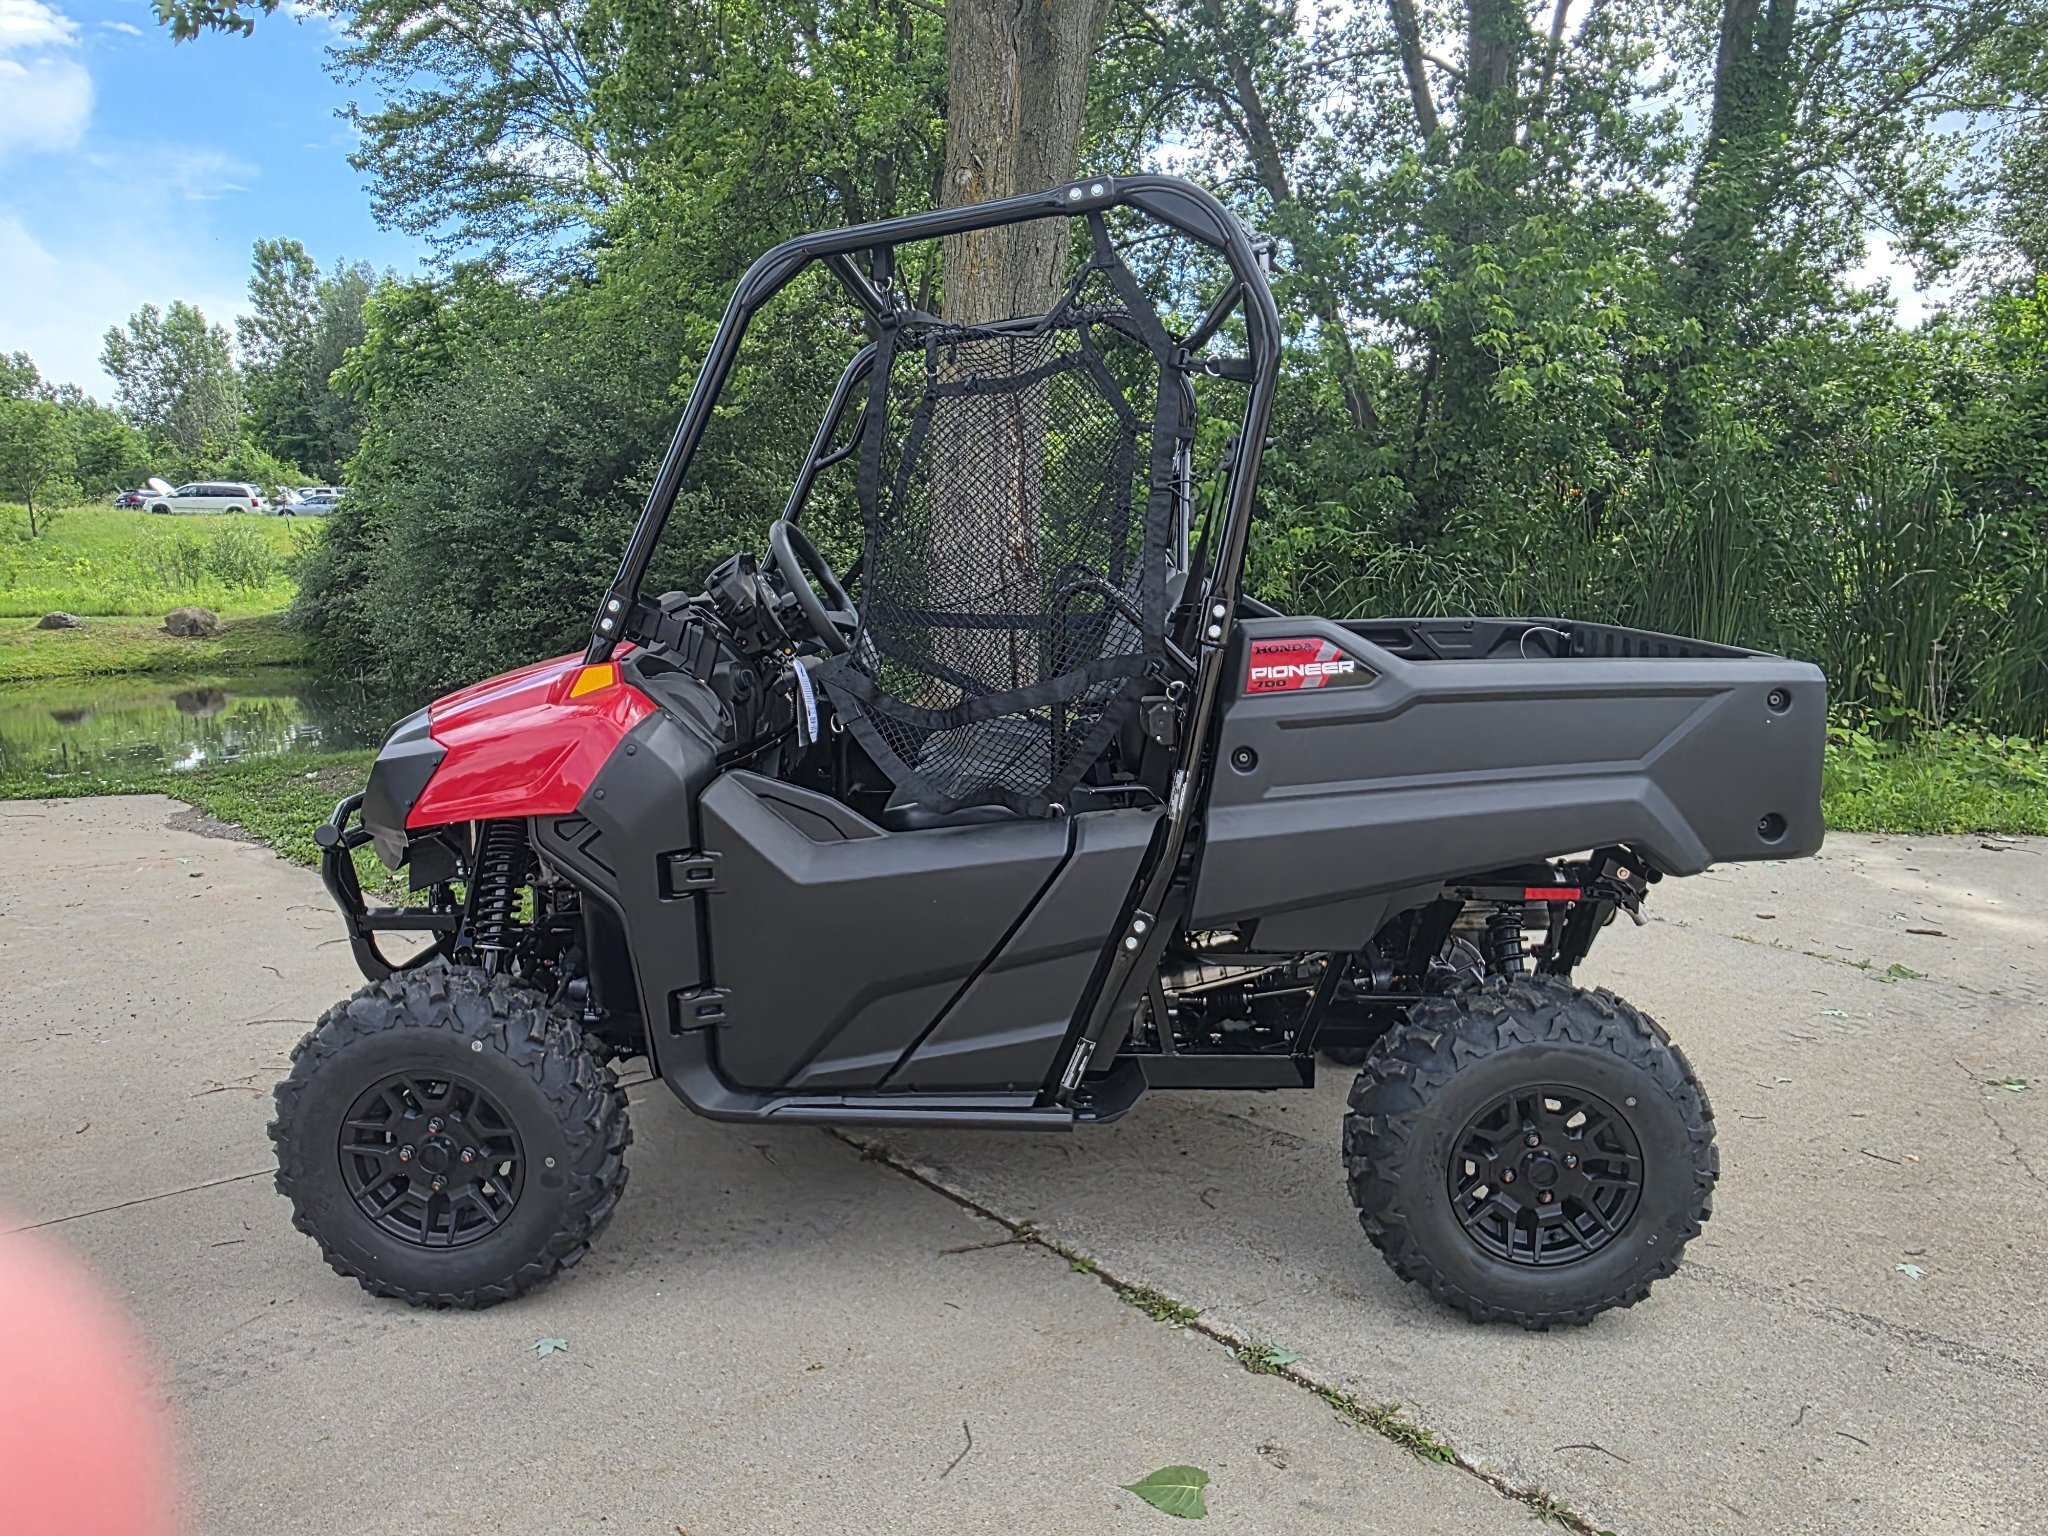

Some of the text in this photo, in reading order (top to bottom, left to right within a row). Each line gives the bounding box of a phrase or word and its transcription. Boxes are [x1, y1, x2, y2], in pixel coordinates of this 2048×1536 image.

[1256, 643, 1314, 655] HONDA
[1251, 661, 1354, 680] PIONEER
[1254, 680, 1287, 688] 700
